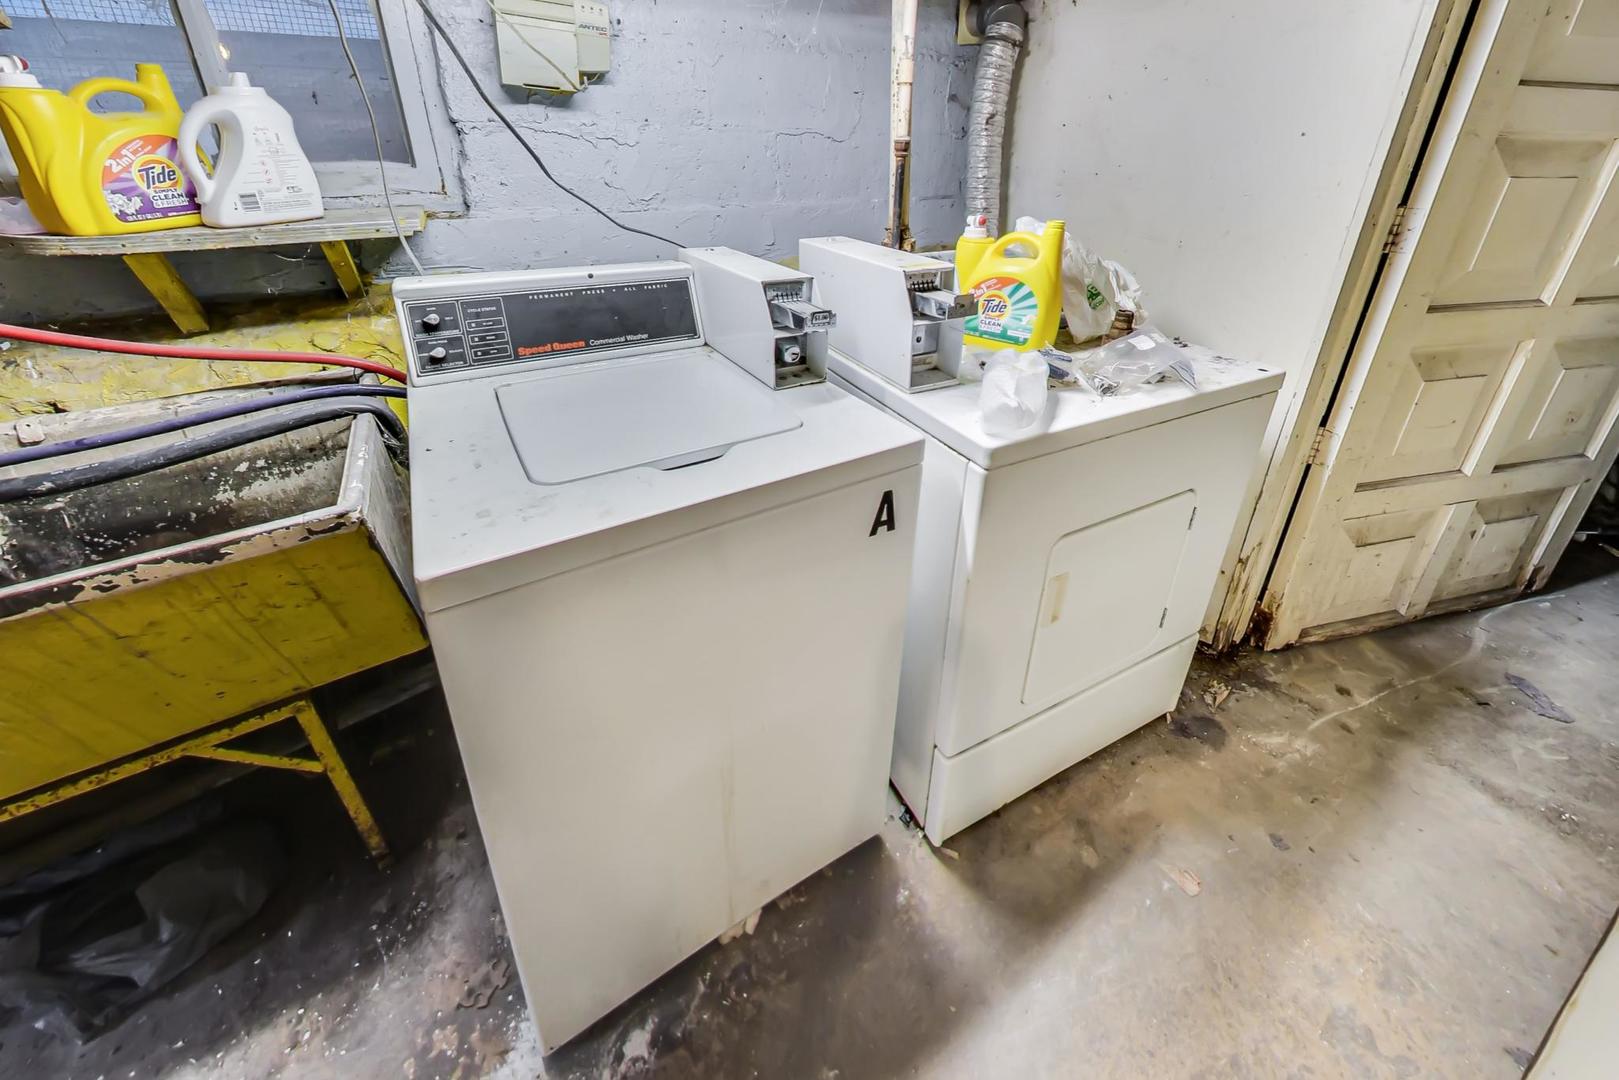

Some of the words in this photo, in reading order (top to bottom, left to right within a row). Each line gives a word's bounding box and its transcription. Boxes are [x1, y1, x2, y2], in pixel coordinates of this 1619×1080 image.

[578, 23, 608, 32] ANTEC
[137, 165, 177, 190] Tide
[152, 193, 185, 201] CLEAN
[529, 291, 574, 300] PERMANENT
[582, 288, 605, 296] PRESS
[982, 299, 1007, 315] Tide
[518, 343, 552, 356] Speed
[552, 340, 585, 351] Queen
[589, 336, 626, 346] Commercial
[626, 333, 649, 341] Washer
[869, 489, 896, 537] A
